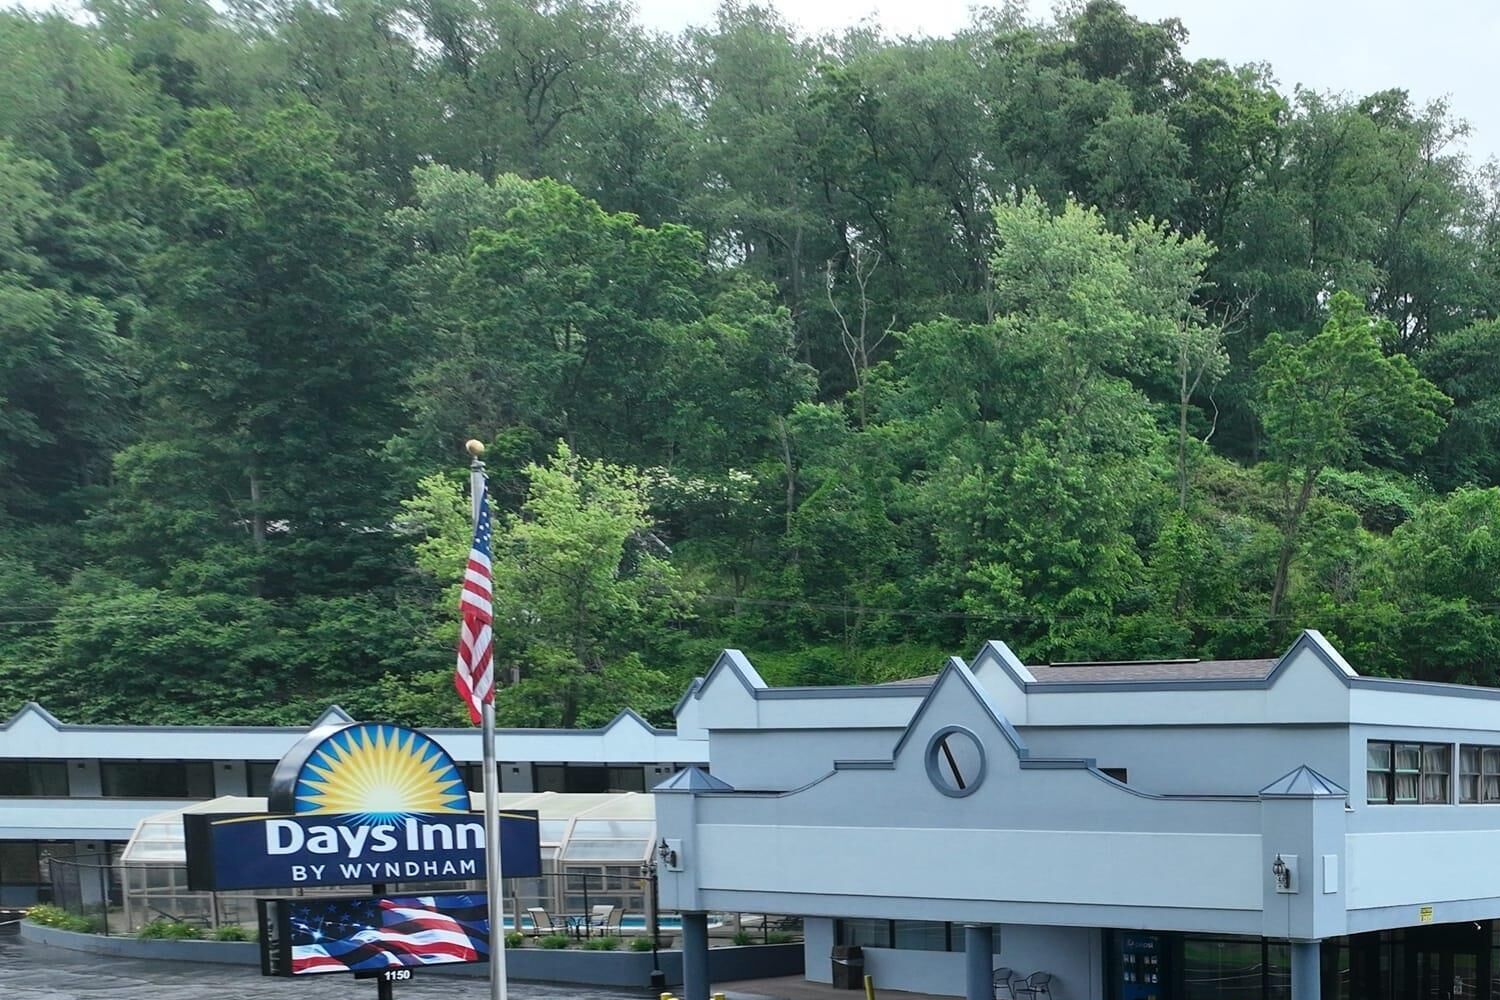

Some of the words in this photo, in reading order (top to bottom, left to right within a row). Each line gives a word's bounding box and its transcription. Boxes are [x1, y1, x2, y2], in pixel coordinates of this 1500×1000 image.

[265, 819, 398, 858] Days
[406, 817, 486, 850] Inn
[292, 864, 325, 881] BY
[339, 860, 476, 879] WYNDHAM
[384, 969, 410, 980] 1150
